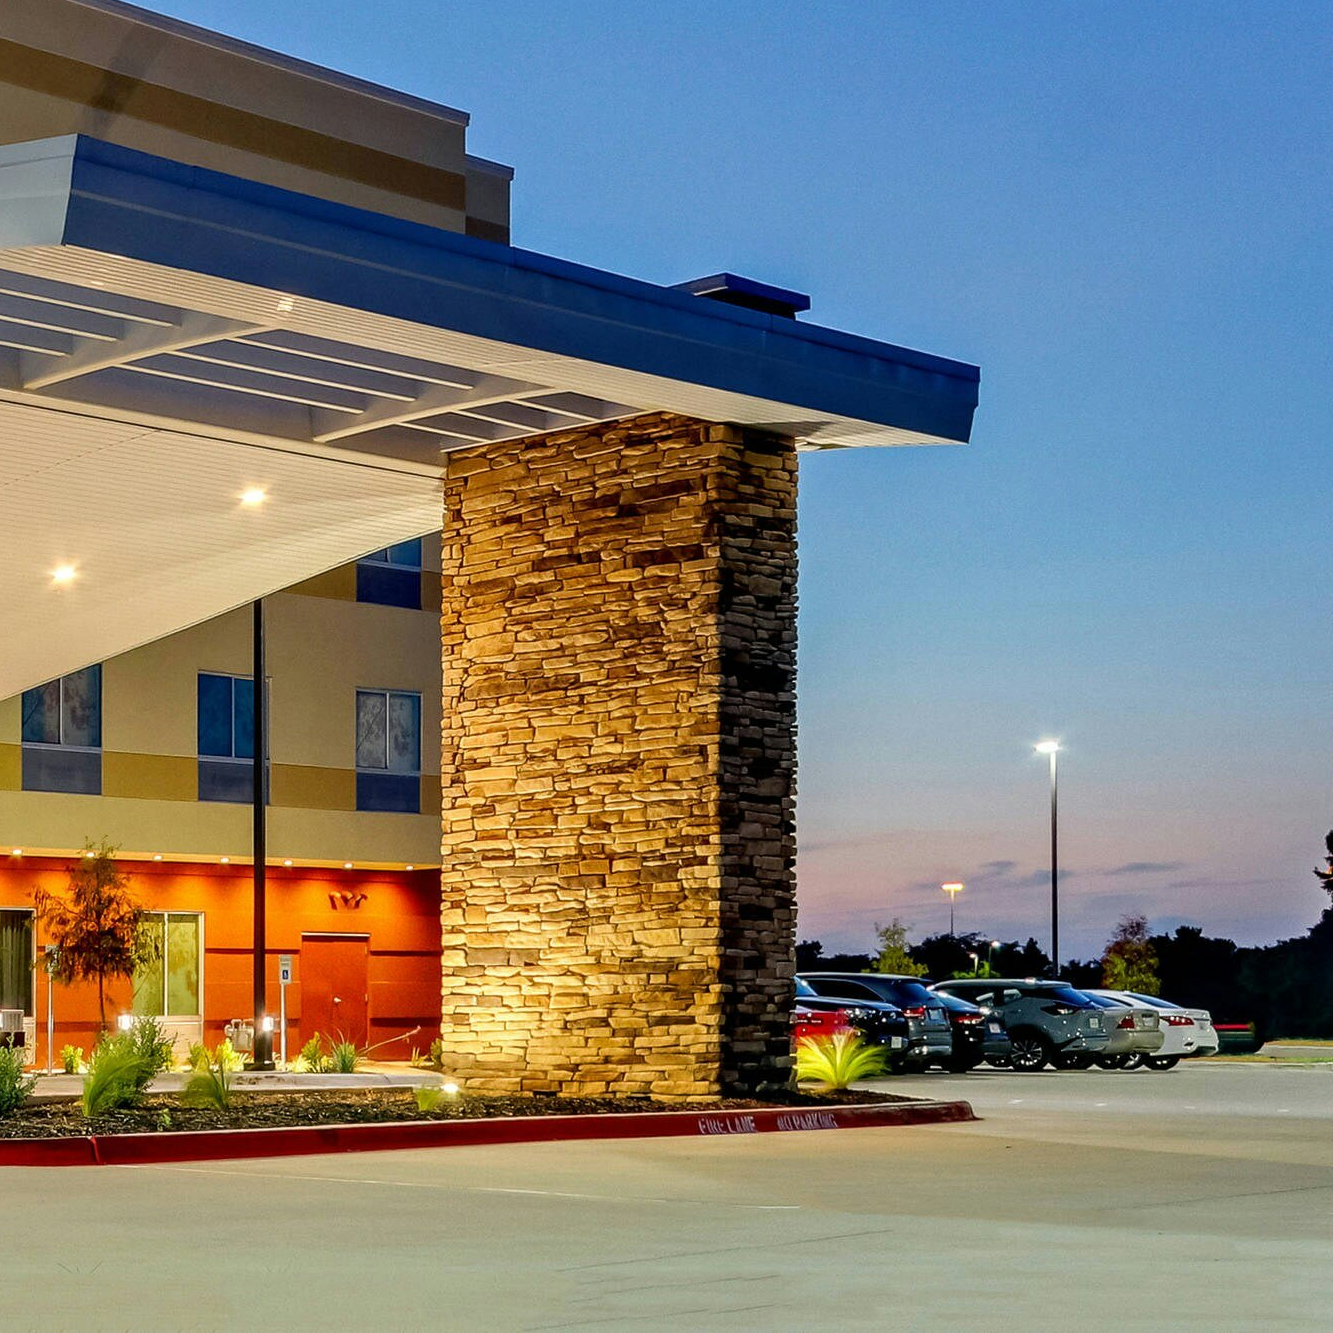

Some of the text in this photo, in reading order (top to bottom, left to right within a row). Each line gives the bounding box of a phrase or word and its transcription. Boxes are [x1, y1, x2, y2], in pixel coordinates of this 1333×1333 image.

[698, 1116, 756, 1135] FIRE LANE
[777, 1112, 838, 1131] NO PARKING
